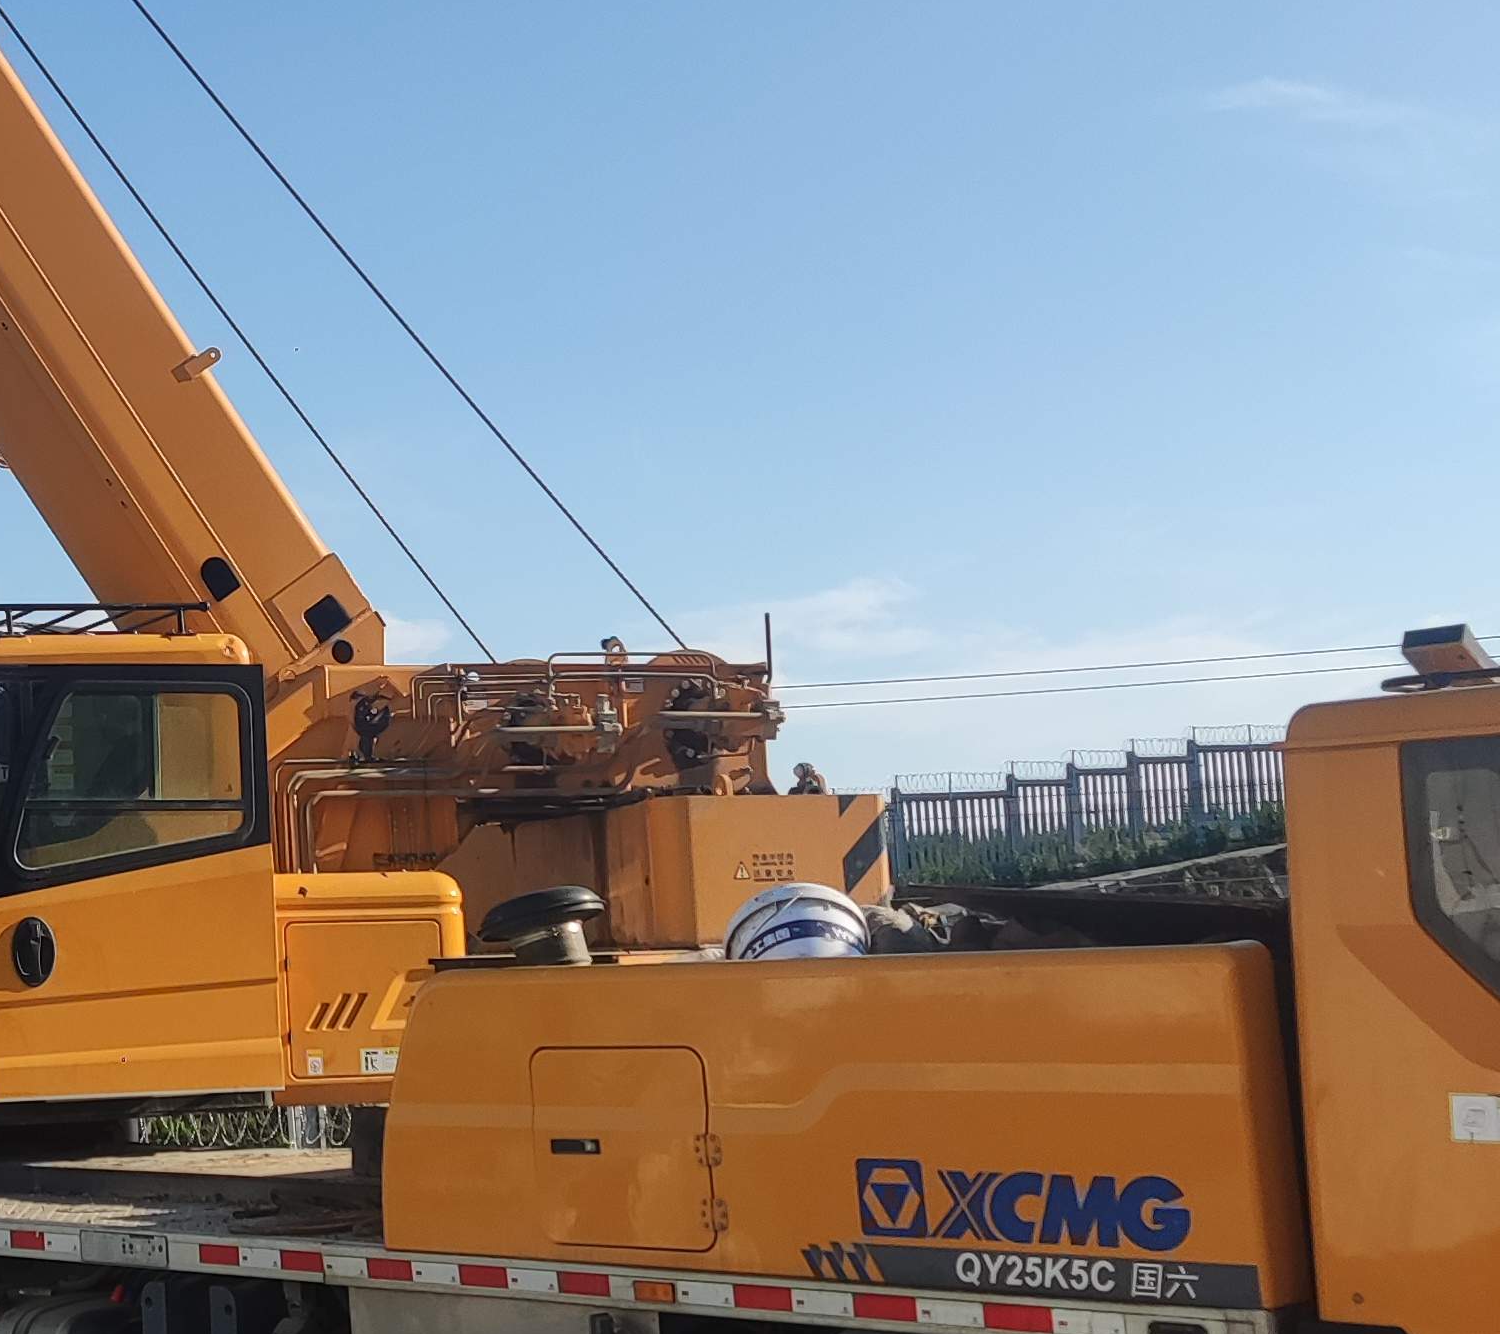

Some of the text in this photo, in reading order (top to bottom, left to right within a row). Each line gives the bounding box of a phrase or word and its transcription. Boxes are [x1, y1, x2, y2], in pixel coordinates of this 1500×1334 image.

[930, 1170, 1191, 1251] XCMG
[955, 1252, 1199, 1301] QY25K5C 国六
